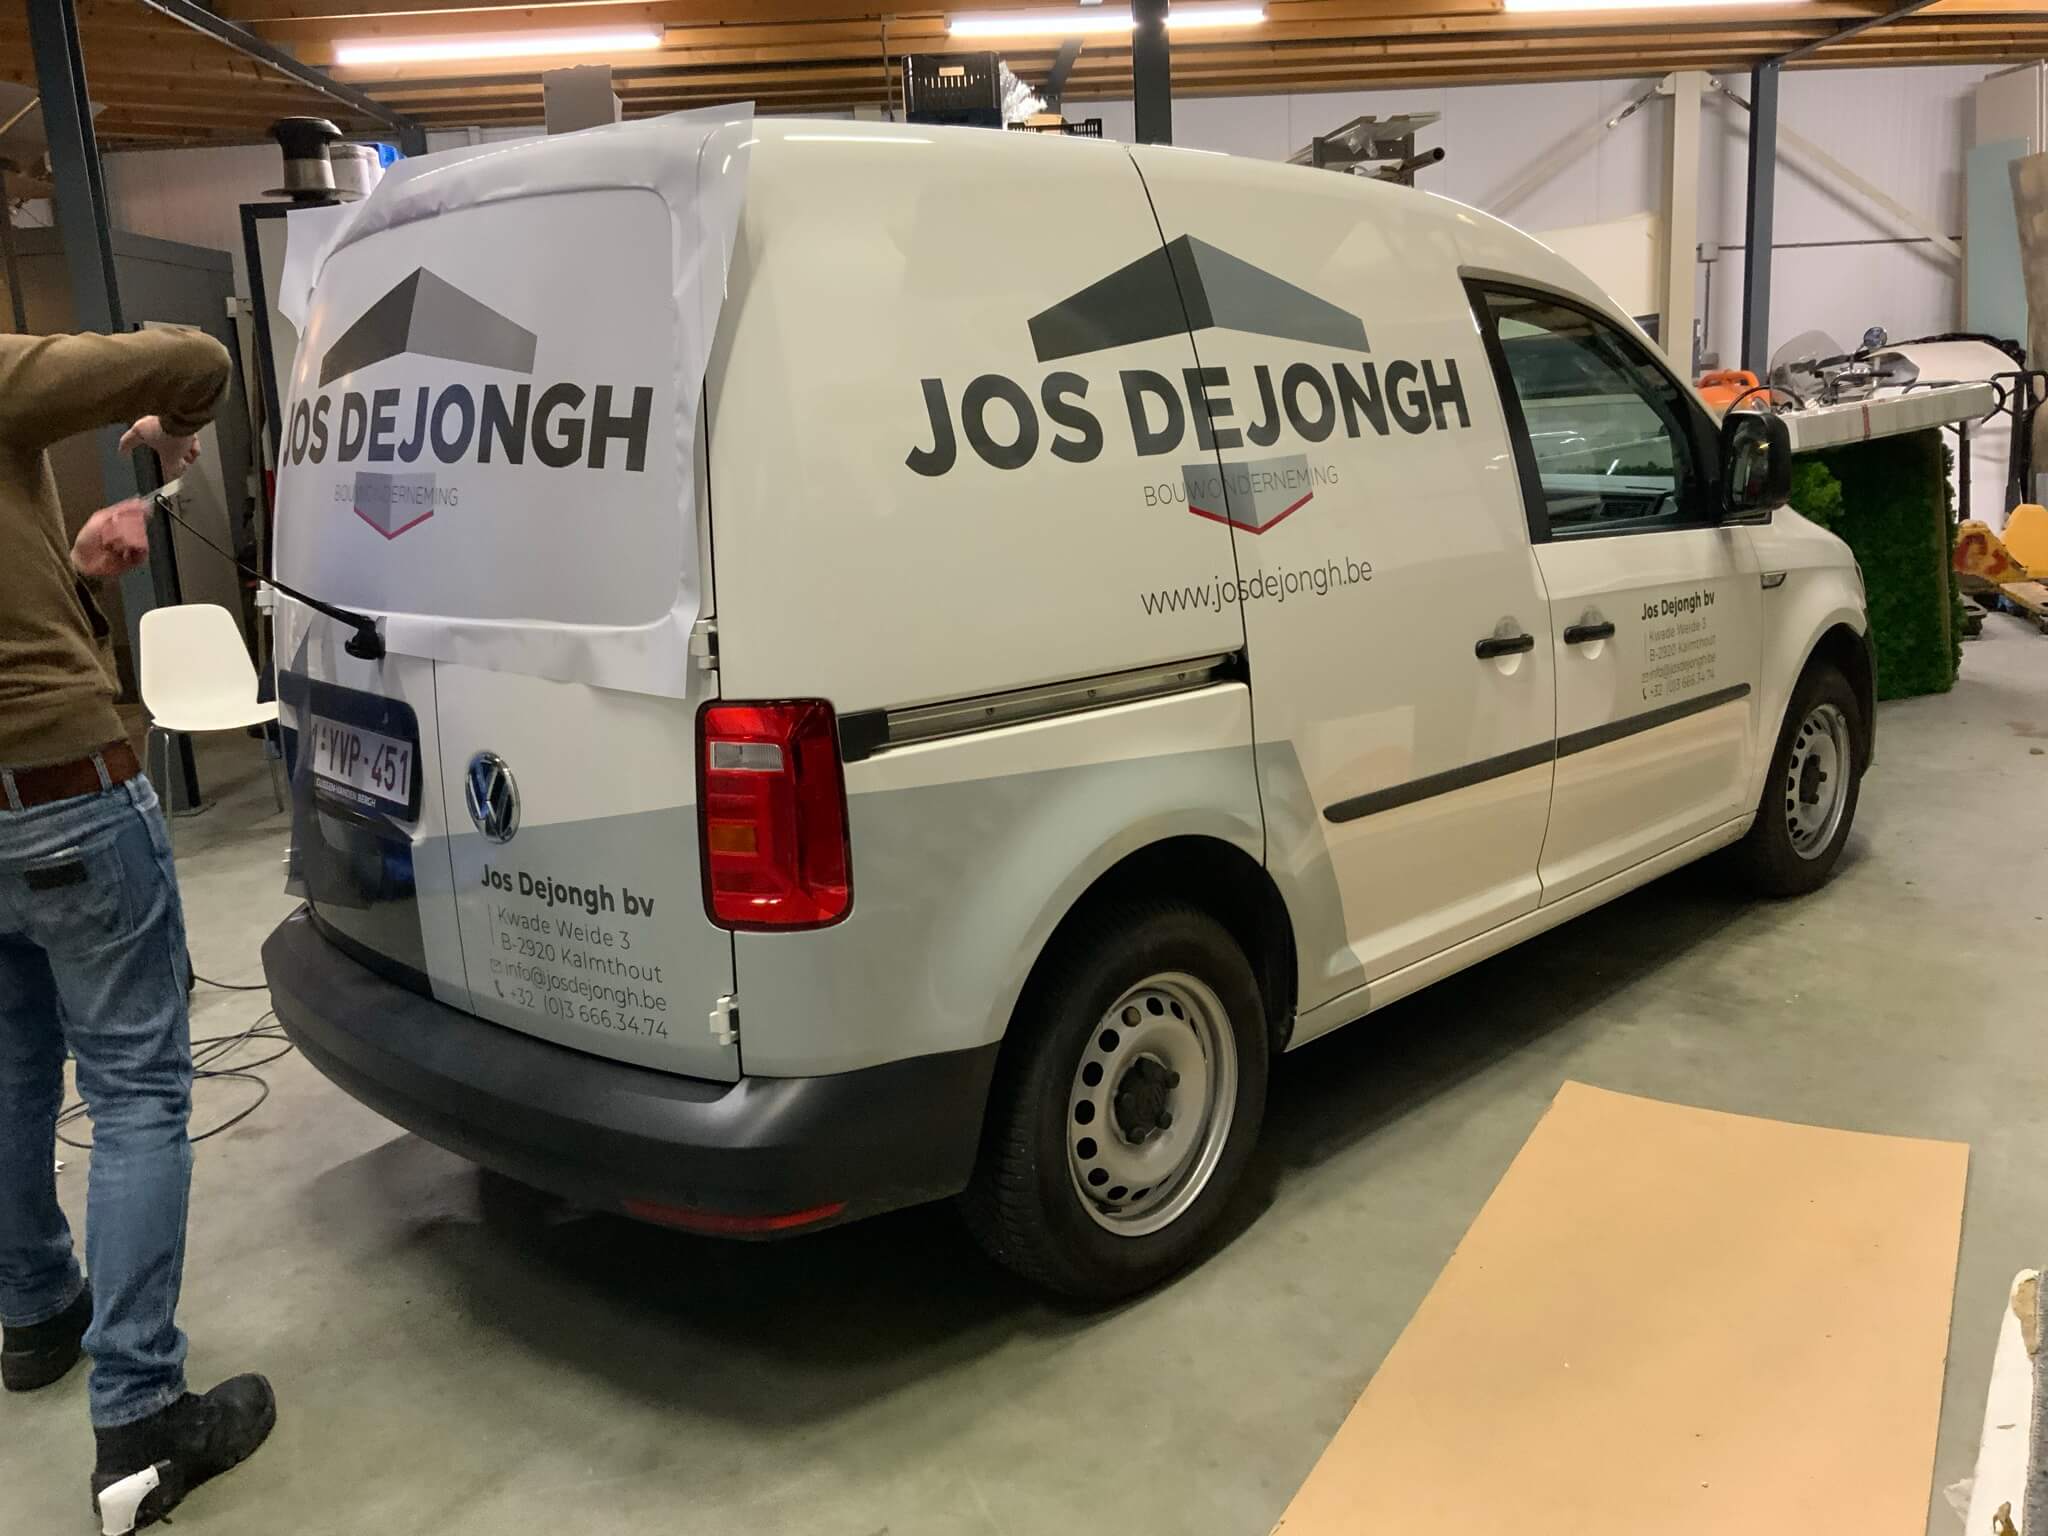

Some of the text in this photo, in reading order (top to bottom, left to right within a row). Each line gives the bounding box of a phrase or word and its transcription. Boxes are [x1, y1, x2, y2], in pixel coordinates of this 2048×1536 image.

[282, 383, 653, 472] JOS DEJONGH
[905, 359, 1471, 477] JOS DEJONGH
[1143, 464, 1339, 508] BOUWONDERNEMING
[1141, 556, 1373, 615] www.josdejongh.be
[1641, 589, 1715, 620] Jos Dejongh bv
[481, 863, 655, 917] Jos Dejongh bv
[498, 904, 631, 950] Kwade Weide 3
[501, 932, 663, 984] B-2920 Kalmthout
[505, 961, 667, 1012] info@josdejongh.be
[579, 1005, 669, 1039] 666.34.74
